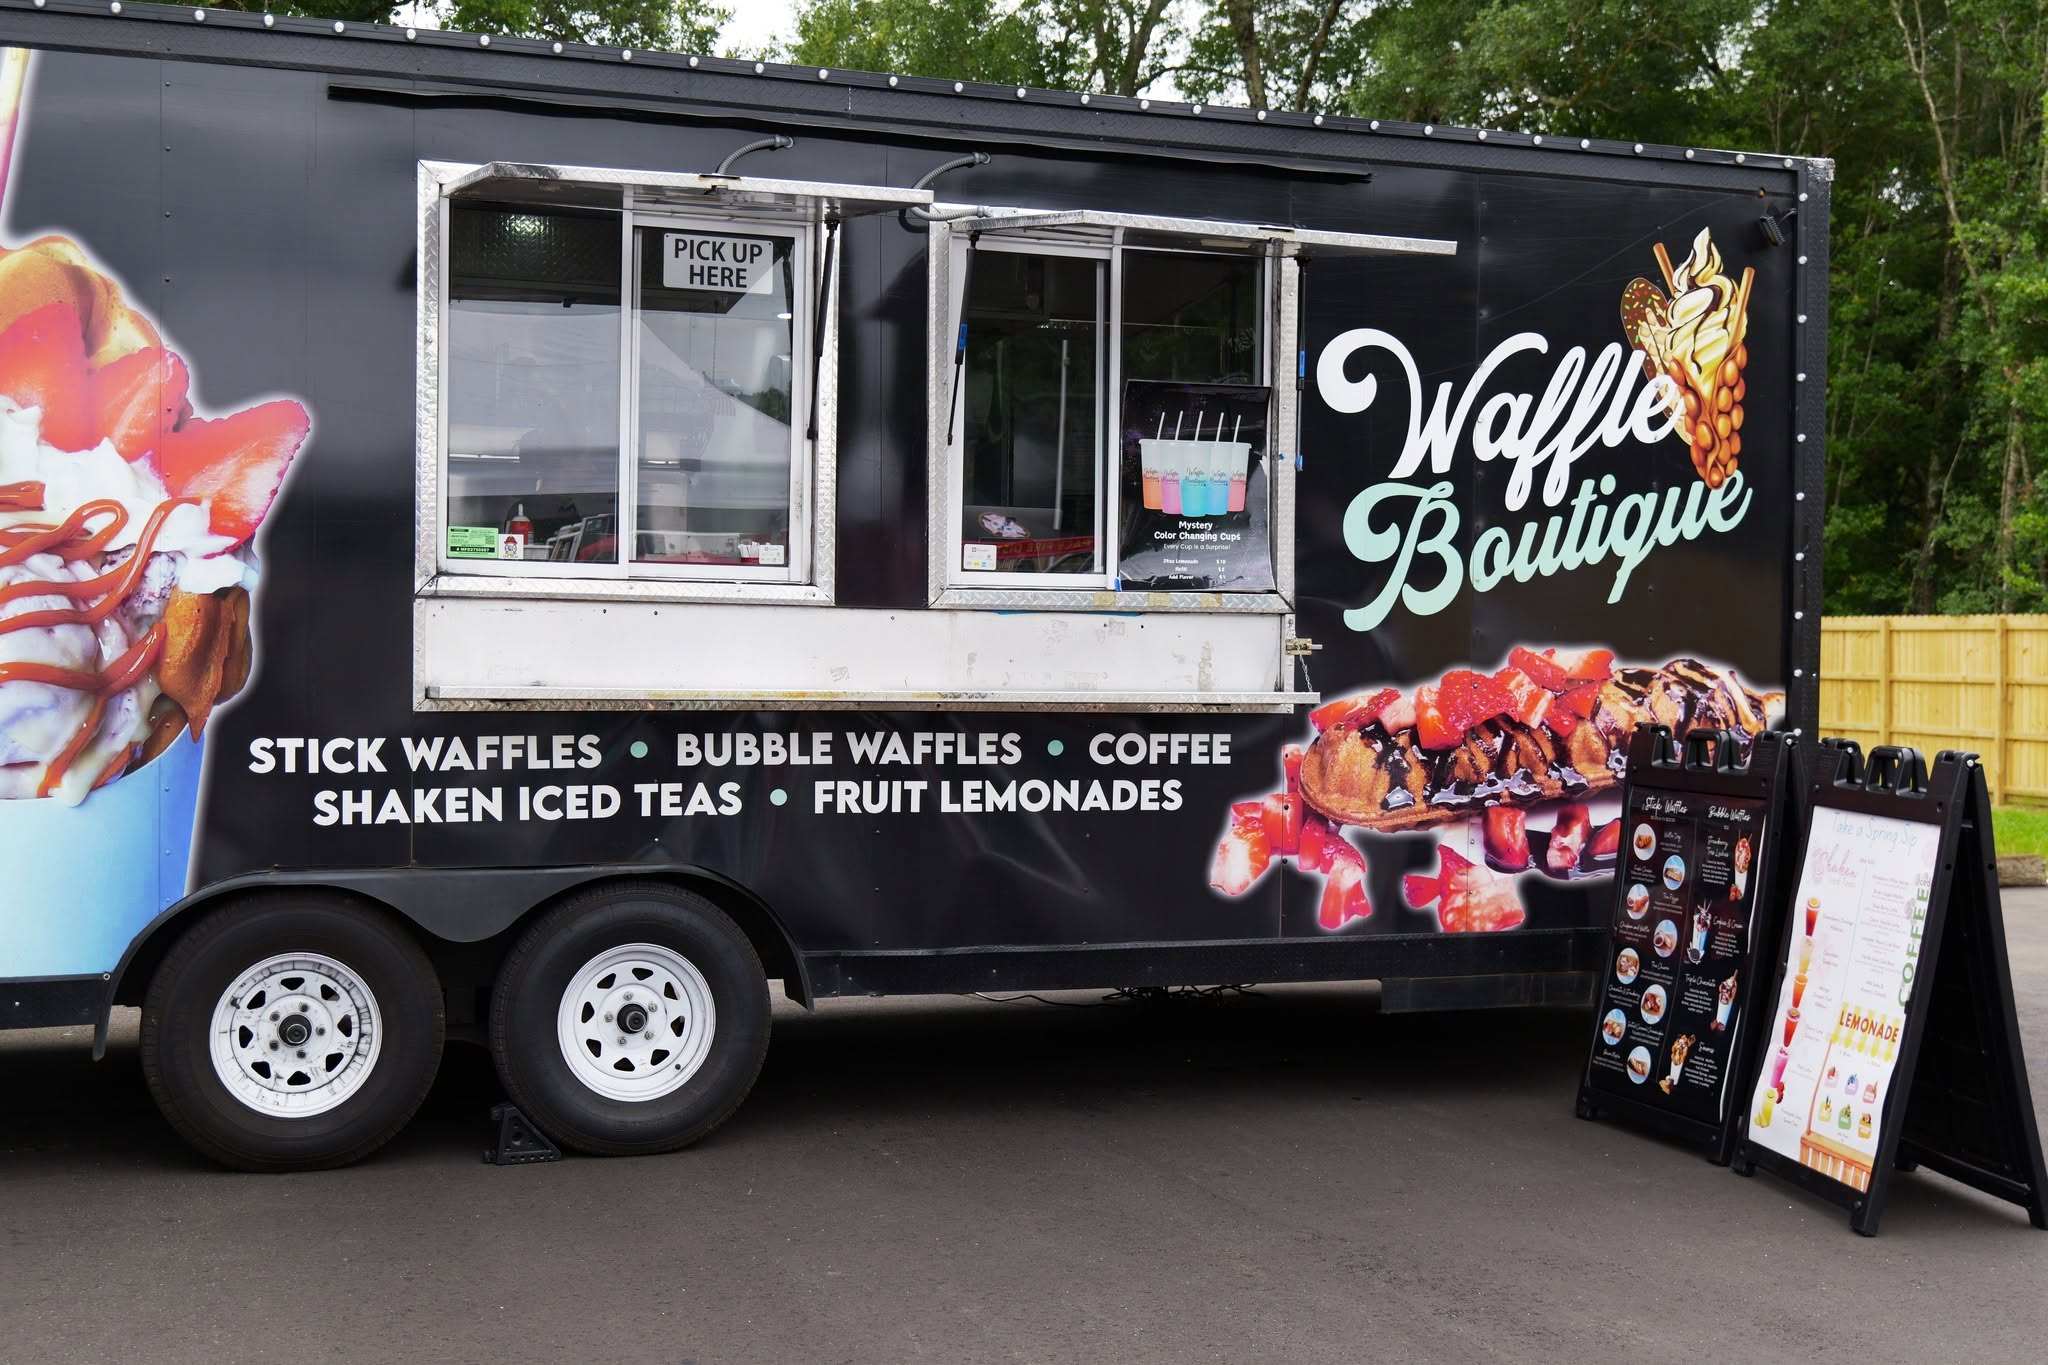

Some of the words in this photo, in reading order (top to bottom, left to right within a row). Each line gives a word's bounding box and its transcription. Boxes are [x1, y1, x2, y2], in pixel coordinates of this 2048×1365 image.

[674, 238, 726, 262] PICK
[732, 242, 763, 264] UP
[689, 264, 747, 288] HERE
[1316, 328, 1685, 511] Waffle
[1154, 531, 1177, 540] Color
[1179, 531, 1218, 542] Changing
[1220, 533, 1241, 542] Cups
[1178, 521, 1213, 530] Mystery
[1163, 543, 1179, 551] Every
[1180, 543, 1193, 551] Cup
[1343, 469, 1753, 632] Boutique
[249, 738, 388, 774] STICK
[401, 735, 602, 772] WAFFLES
[677, 732, 833, 767] BUBBLE
[846, 731, 1022, 765] WAFFLES
[1089, 733, 1232, 765] COFFEE
[313, 786, 503, 826] SHAKEN
[519, 785, 621, 821] ICED
[634, 782, 743, 816] TEAS
[814, 780, 928, 814] FRUIT
[941, 779, 1183, 812] LEMONADES
[1642, 795, 1663, 817] Stick
[1665, 799, 1688, 814] Waffles
[1708, 805, 1729, 818] Bubble
[1730, 808, 1751, 822] Waffles
[1832, 812, 1853, 834] Take
[1864, 817, 1899, 853] Spring
[1900, 823, 1919, 856] Sip
[1898, 888, 1929, 1007] COFFEE
[1839, 1011, 1899, 1043] LEMONADE
